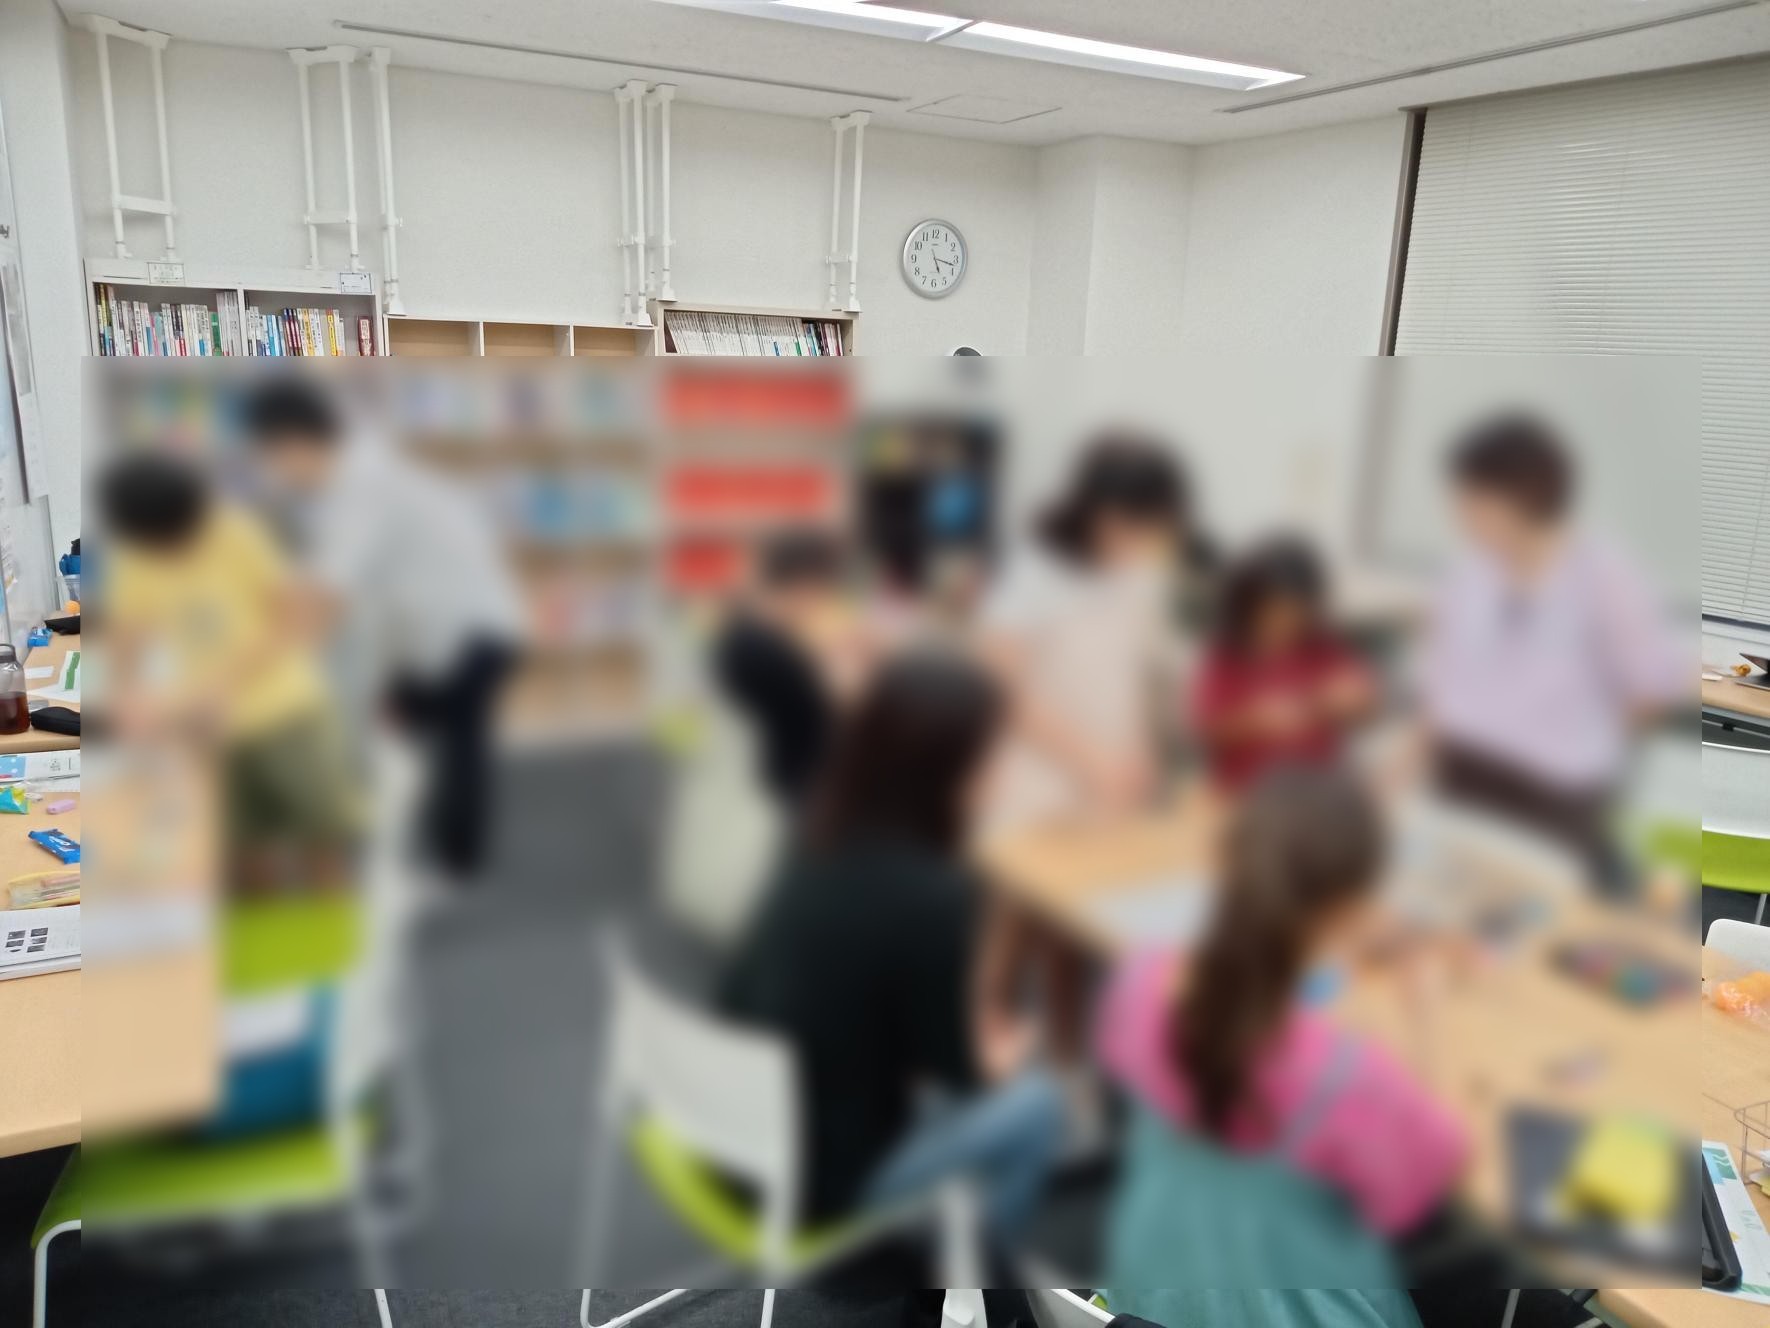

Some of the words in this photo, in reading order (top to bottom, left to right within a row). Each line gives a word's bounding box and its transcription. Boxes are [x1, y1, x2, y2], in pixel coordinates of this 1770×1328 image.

[922, 232, 929, 242] 11
[931, 229, 940, 239] 12
[944, 232, 948, 242] 1
[914, 241, 923, 251] 10
[950, 242, 956, 252] 2
[910, 254, 917, 264] 9
[953, 255, 959, 264] 3
[914, 267, 920, 276] 8
[921, 276, 927, 285] 7
[930, 278, 937, 288] 6
[941, 276, 947, 286] 5
